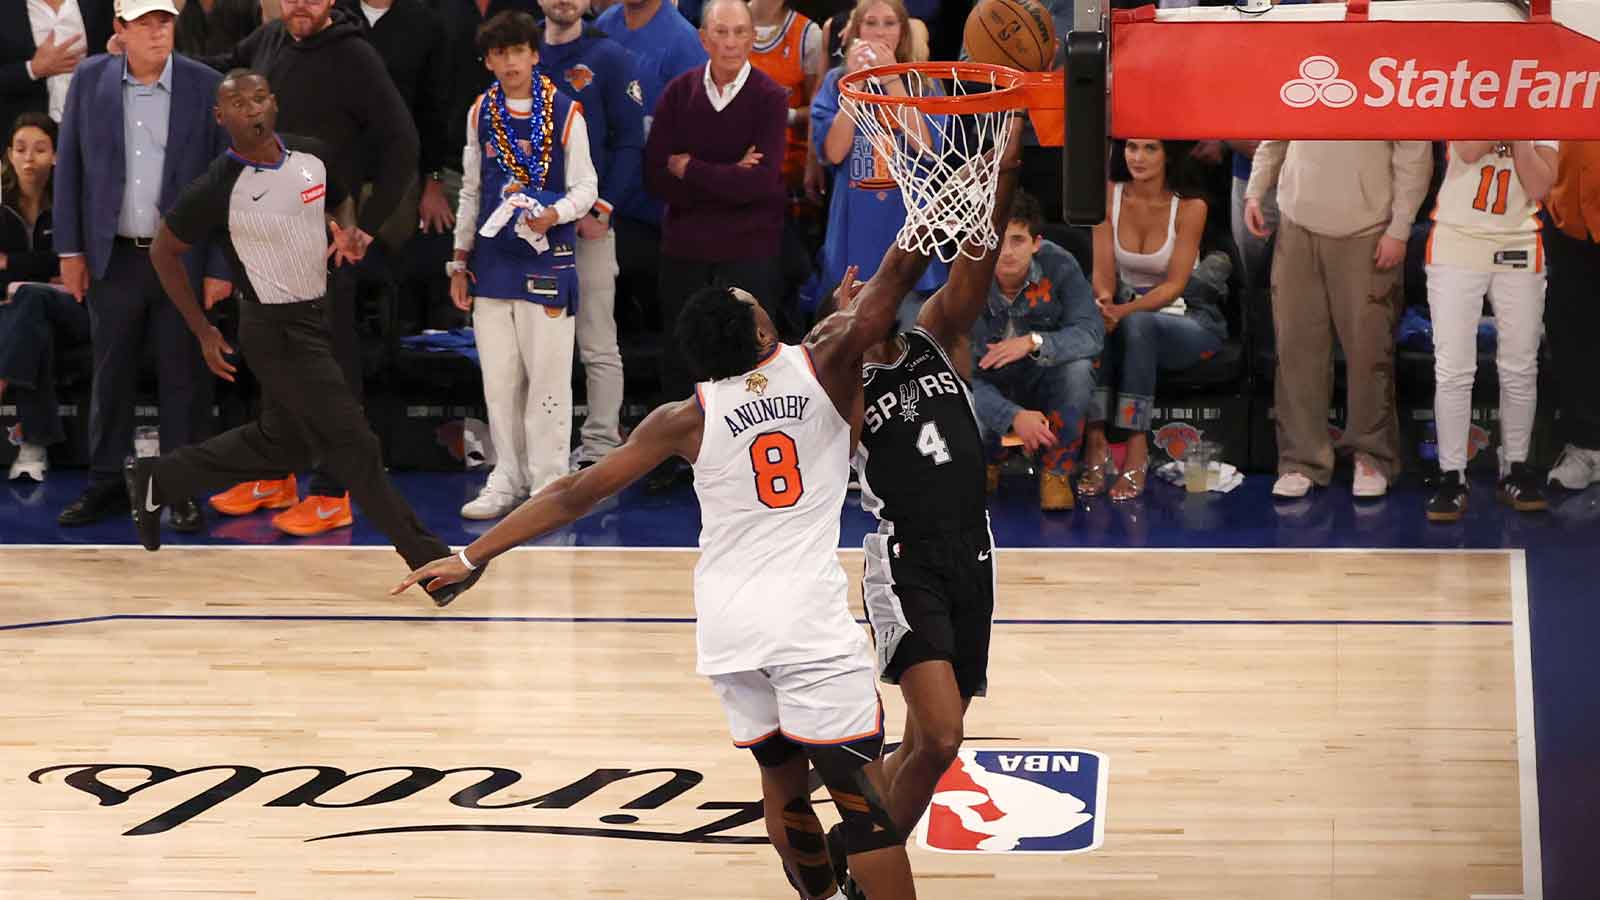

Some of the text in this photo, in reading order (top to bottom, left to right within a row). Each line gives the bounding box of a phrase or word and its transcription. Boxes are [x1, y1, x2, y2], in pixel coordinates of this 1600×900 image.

[1363, 56, 1500, 109] State
[1472, 164, 1512, 215] 11
[724, 395, 810, 438] ANUNOBY
[863, 371, 959, 435] SPURS
[916, 420, 953, 466] 4
[749, 430, 805, 509] 8
[998, 754, 1079, 772] NBA
